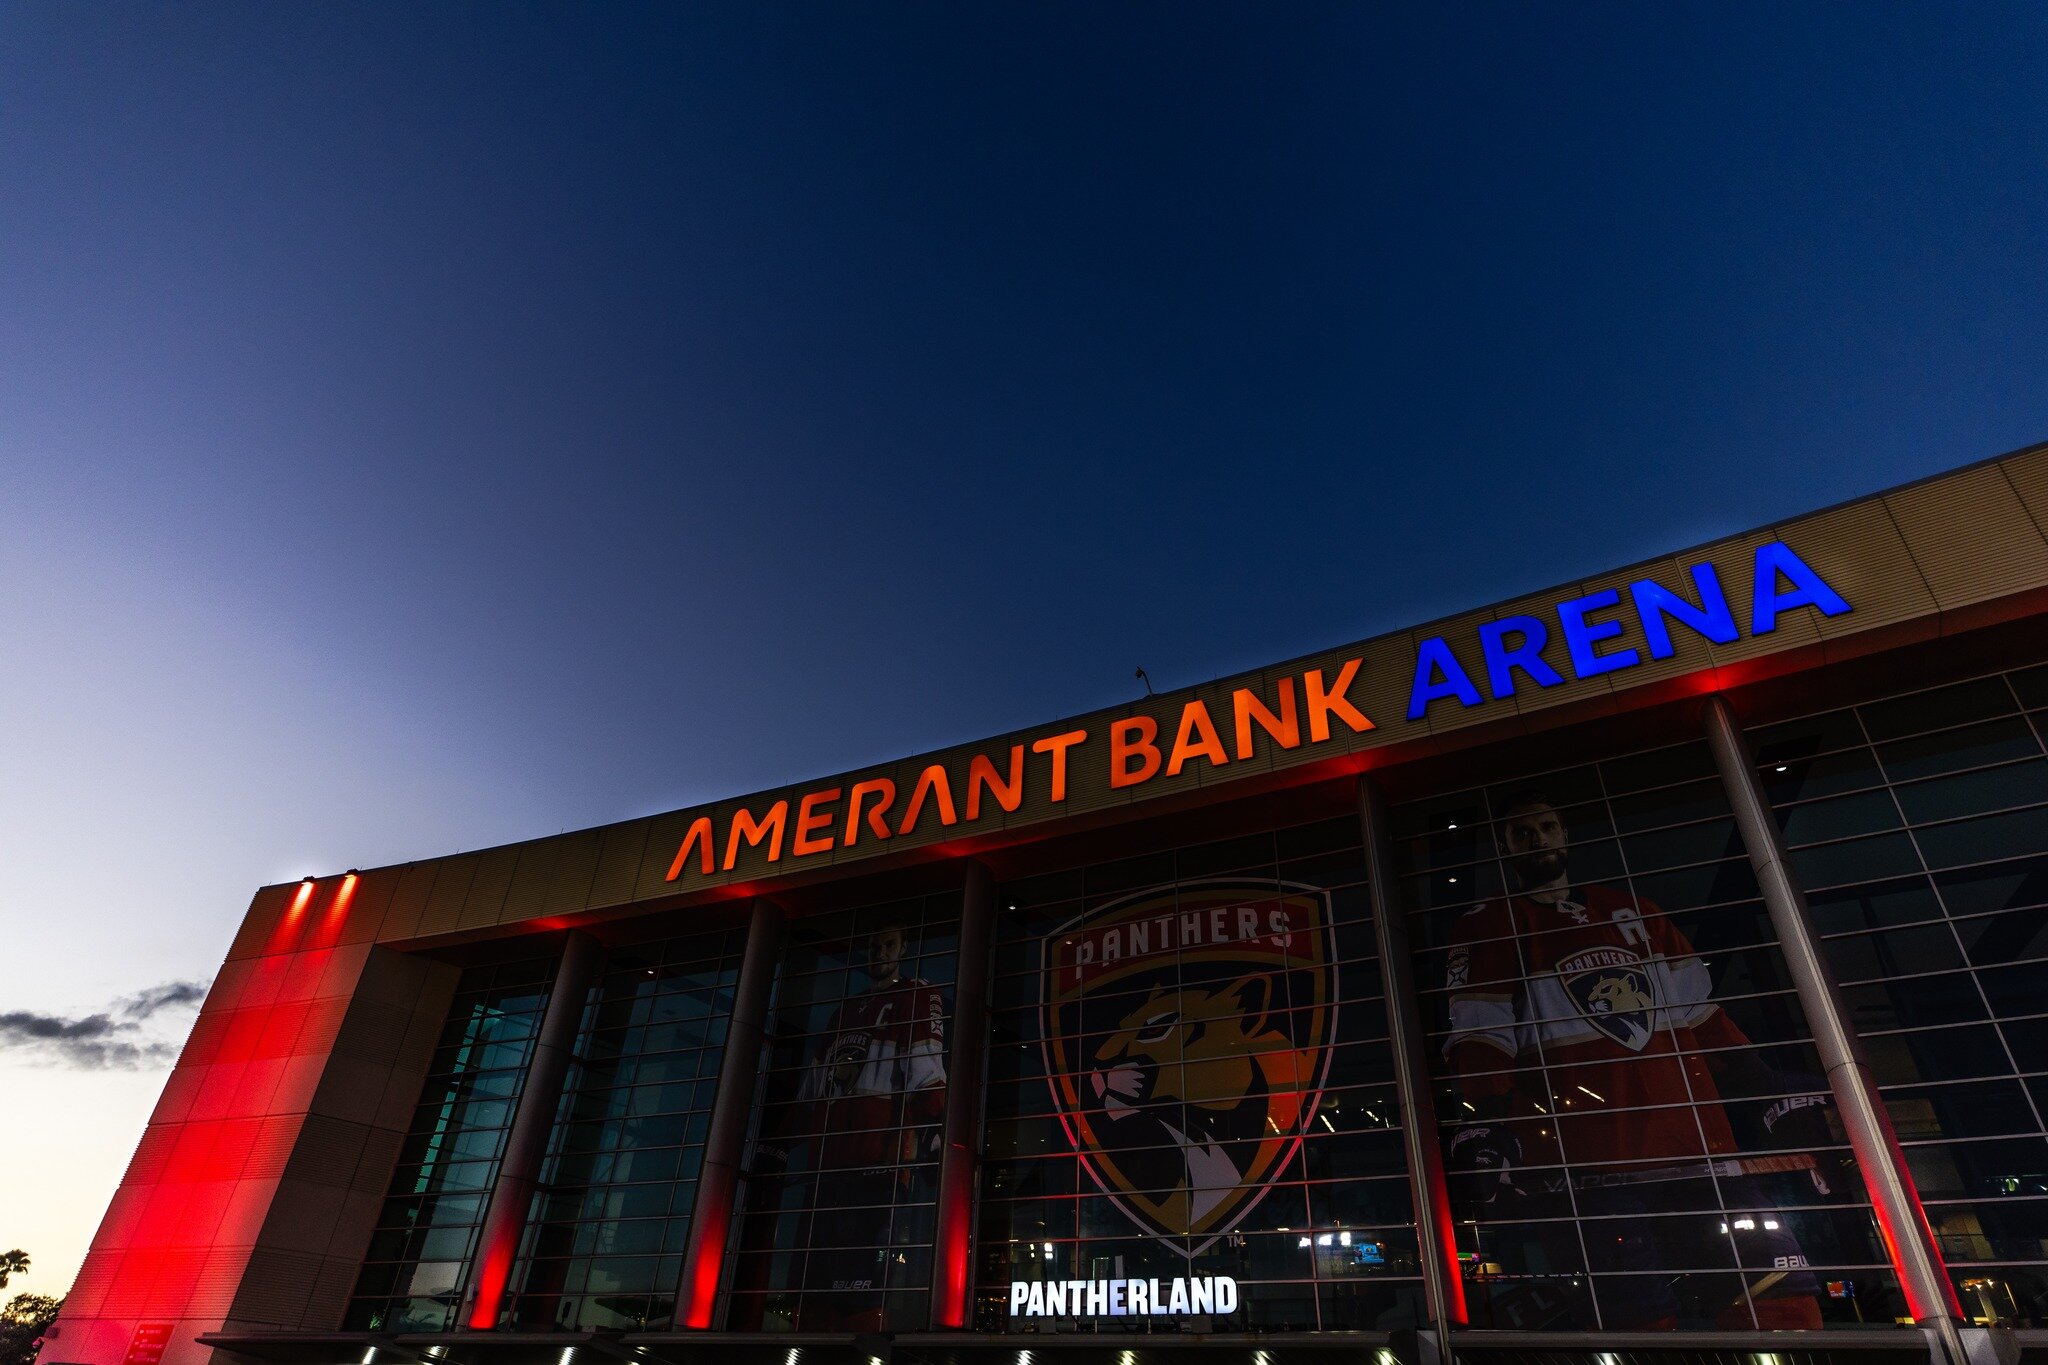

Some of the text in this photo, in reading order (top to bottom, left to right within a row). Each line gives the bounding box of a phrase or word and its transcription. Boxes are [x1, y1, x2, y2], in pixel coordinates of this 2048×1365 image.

[665, 541, 1853, 882] AMERANT BANK ARENA
[1075, 907, 1294, 981] PANTHERS
[1010, 1276, 1238, 1316] PANTHERLAND
